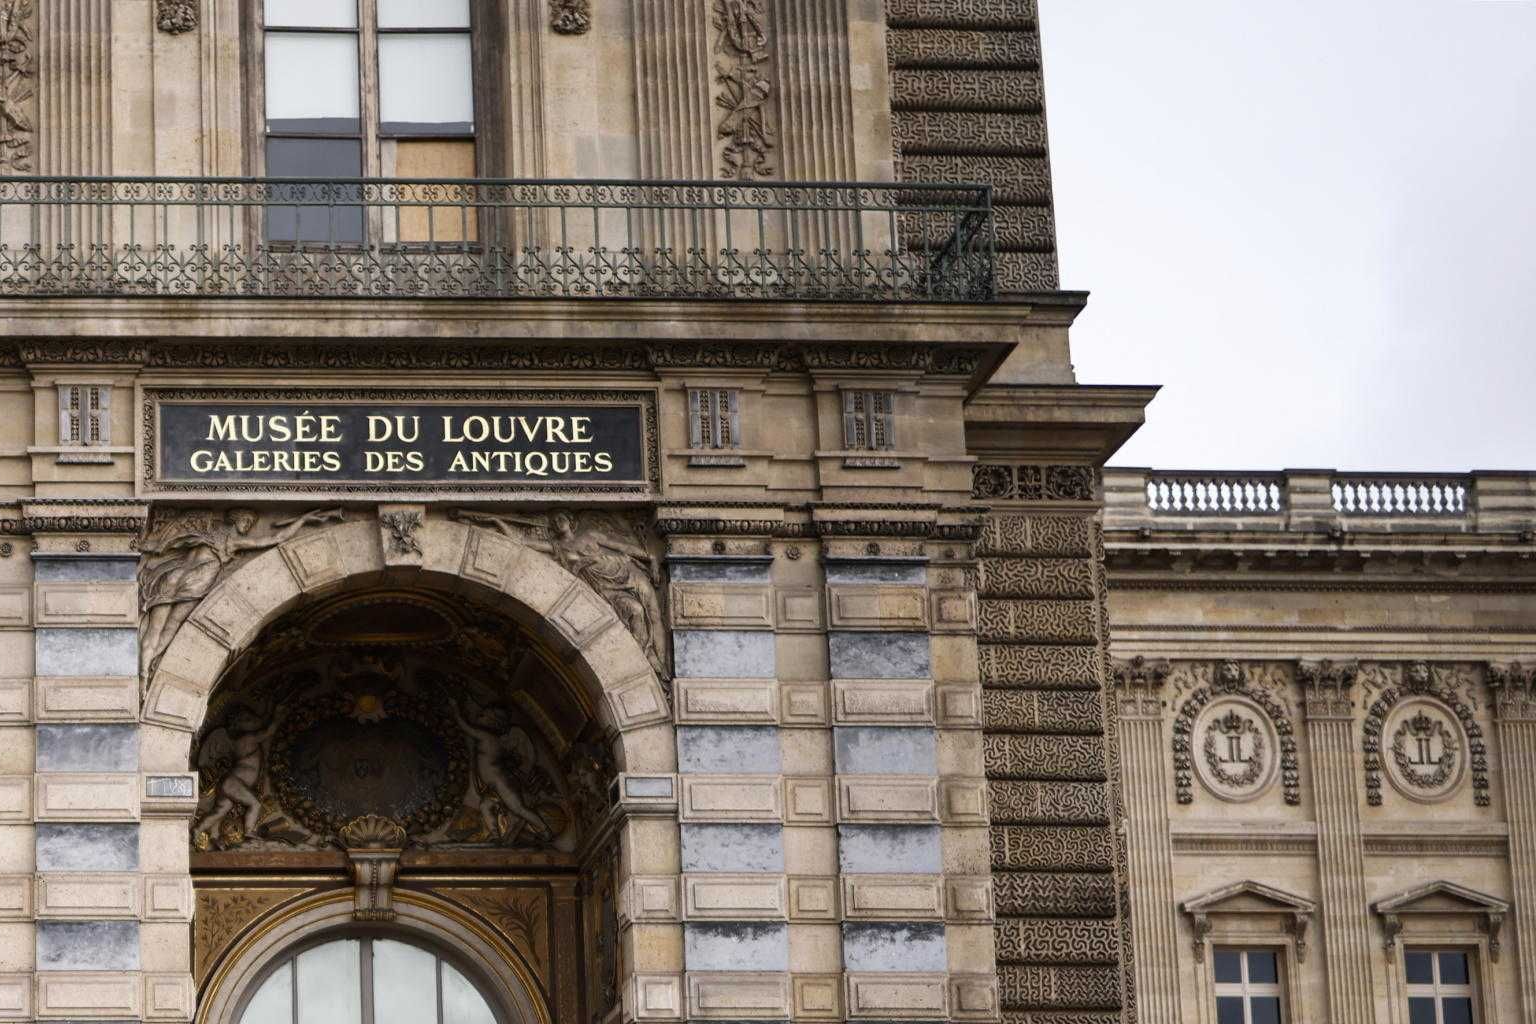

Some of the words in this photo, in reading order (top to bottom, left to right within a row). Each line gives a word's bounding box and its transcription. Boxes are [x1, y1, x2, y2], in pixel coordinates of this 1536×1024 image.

[206, 410, 343, 443] MUSÉE
[368, 415, 420, 443] DU
[442, 416, 593, 443] LOUVRE
[190, 450, 342, 473] GALERIES
[365, 452, 425, 472] DES
[449, 452, 613, 476] ANTIQUES
